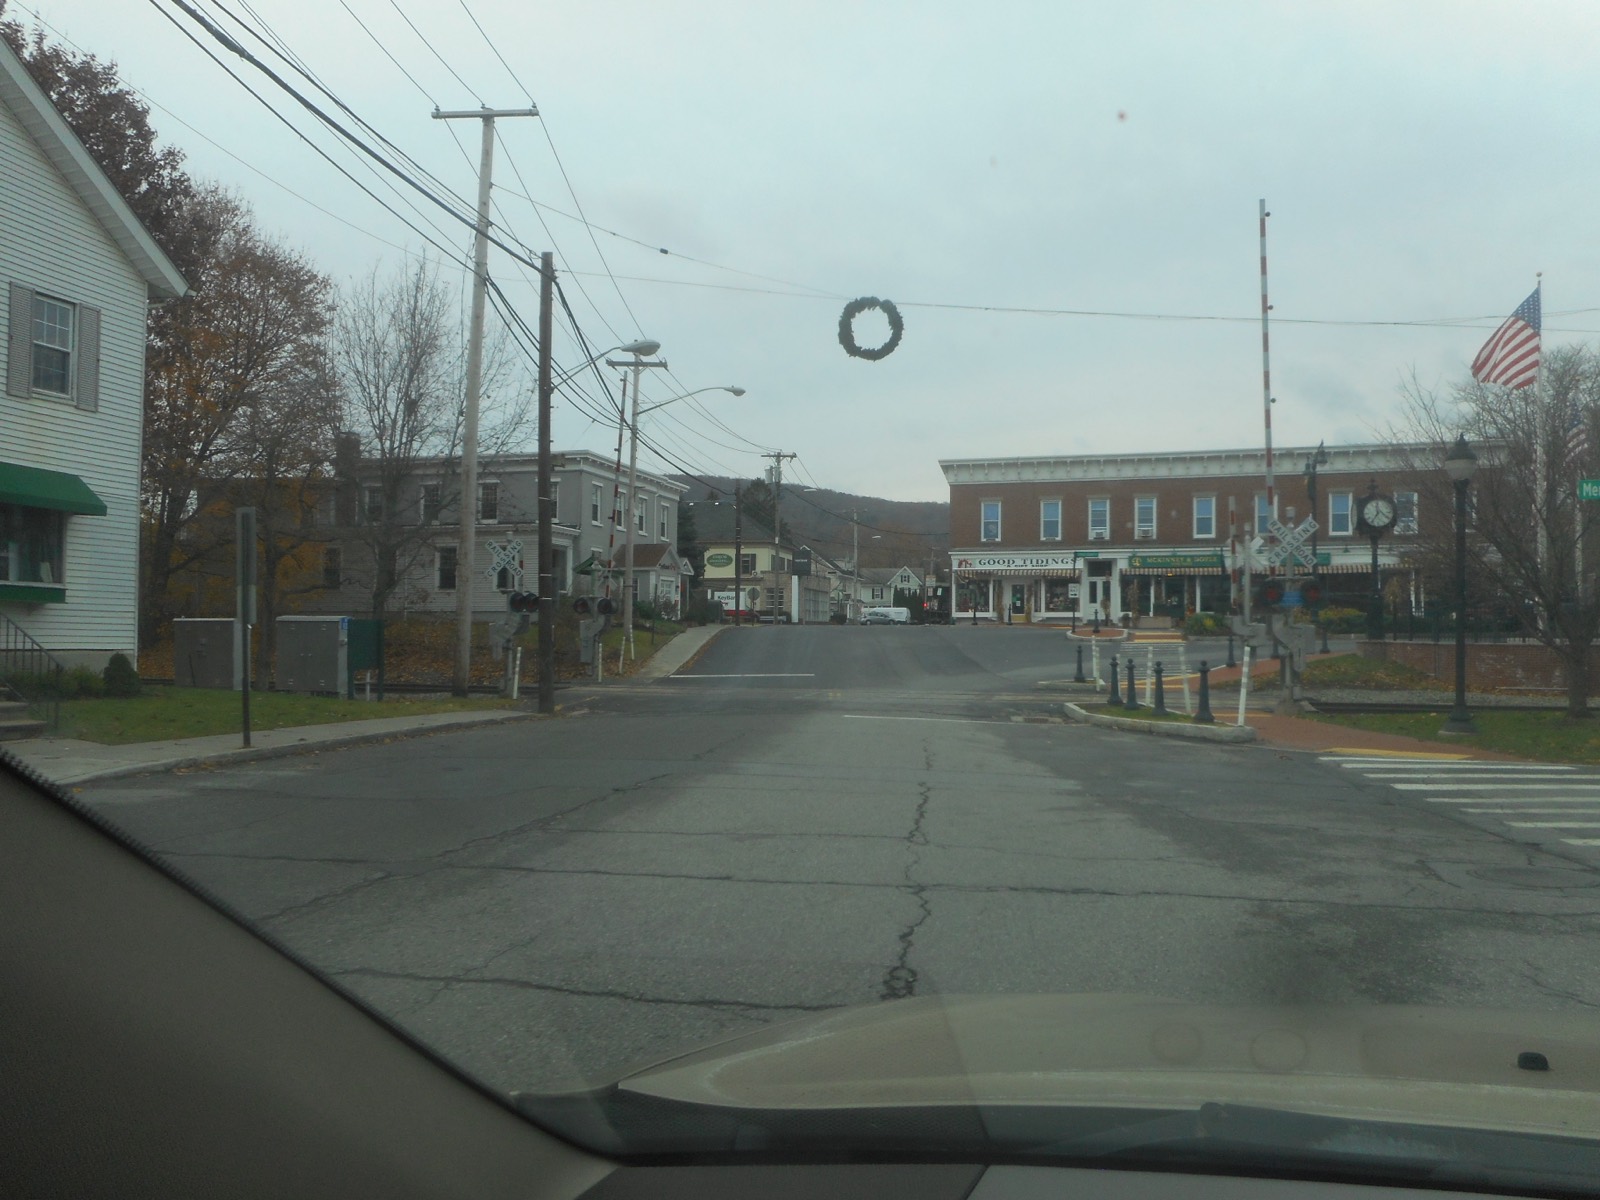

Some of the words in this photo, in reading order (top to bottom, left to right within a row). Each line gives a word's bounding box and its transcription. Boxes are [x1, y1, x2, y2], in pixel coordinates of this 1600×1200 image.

[1583, 482, 1600, 497] Me
[1268, 521, 1317, 564] CROSSING
[486, 541, 522, 577] CROSSING
[1020, 557, 1076, 565] TIDINGS
